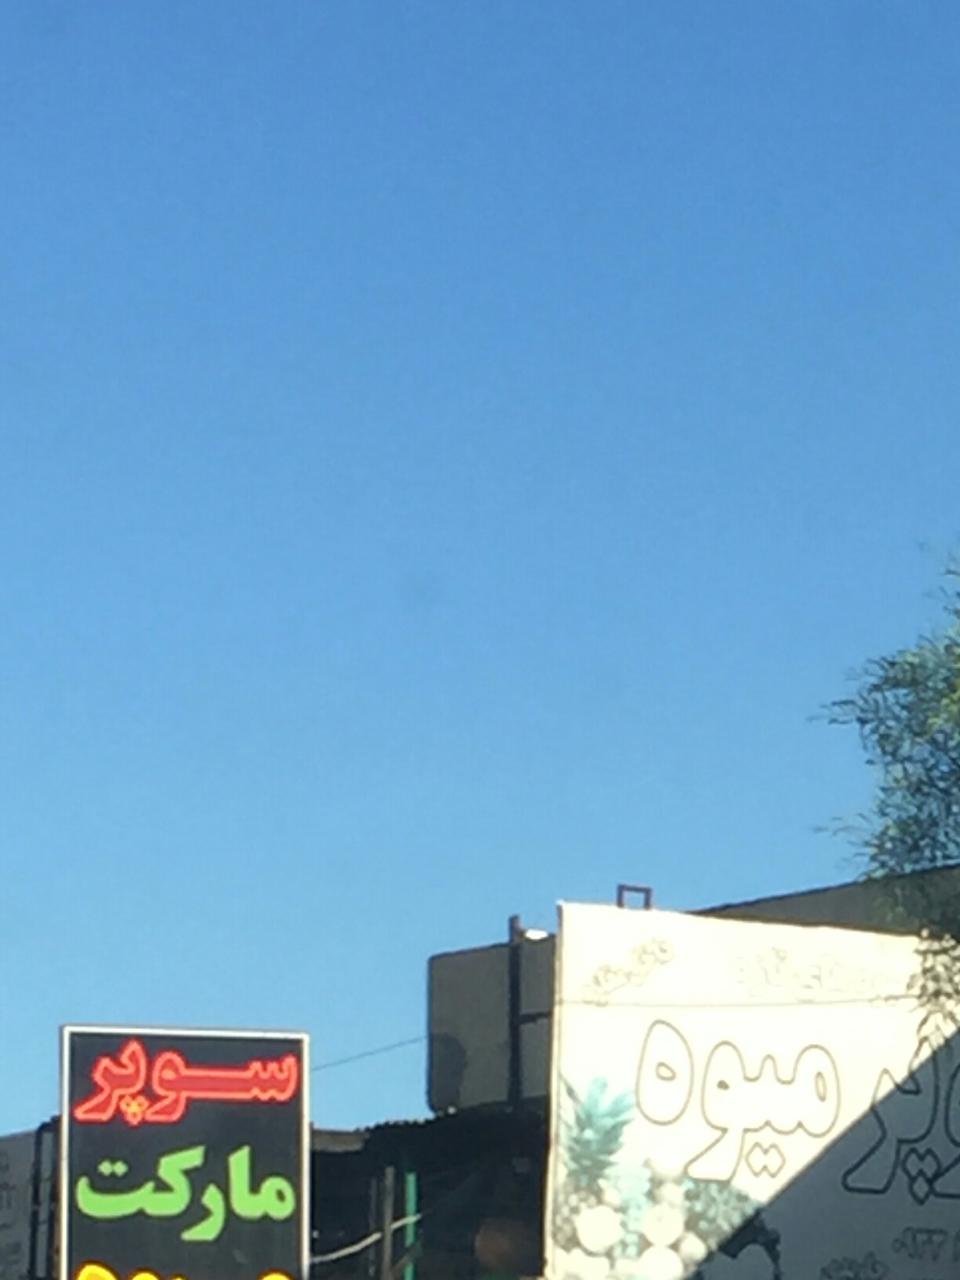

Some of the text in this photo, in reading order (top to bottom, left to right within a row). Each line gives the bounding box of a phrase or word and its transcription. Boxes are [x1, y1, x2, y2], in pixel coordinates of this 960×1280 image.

[74, 1040, 298, 1124] سوپر
[635, 1019, 841, 1182] میوه
[76, 1145, 296, 1241] مارکت
